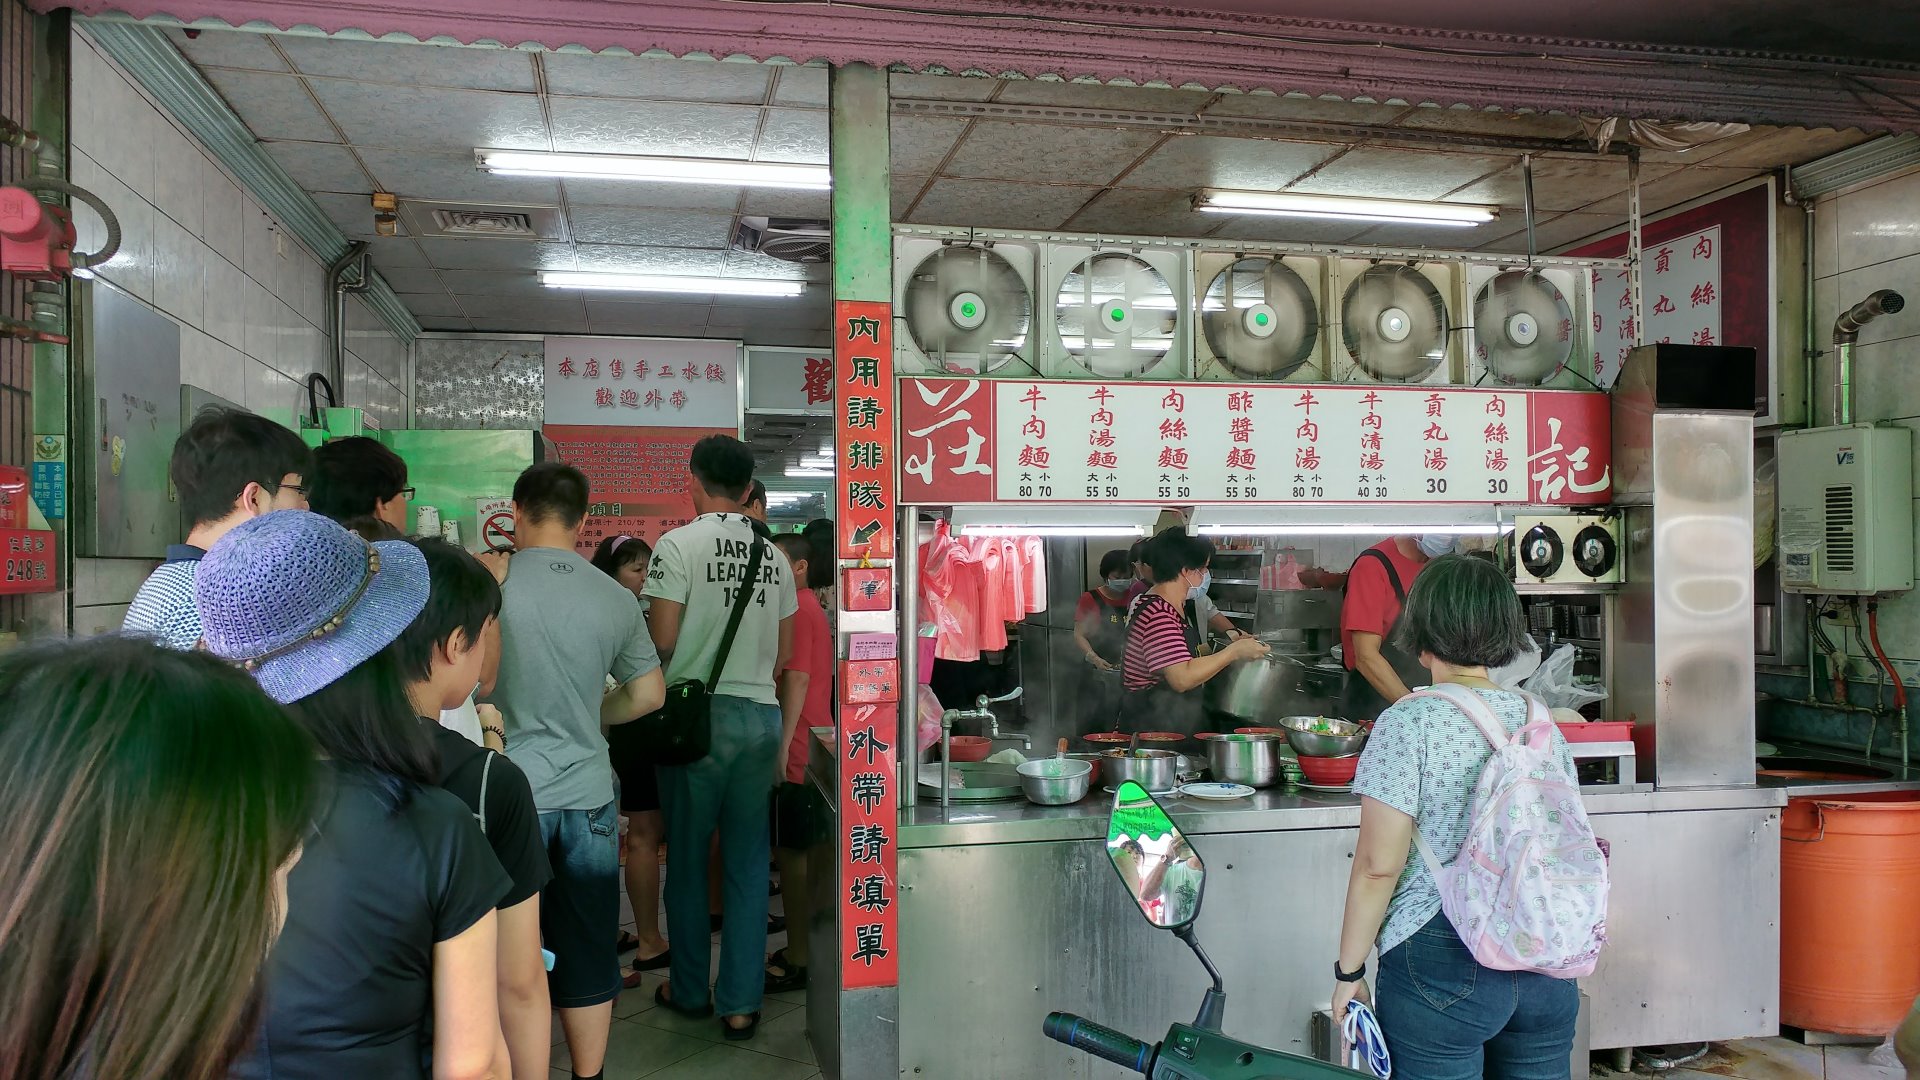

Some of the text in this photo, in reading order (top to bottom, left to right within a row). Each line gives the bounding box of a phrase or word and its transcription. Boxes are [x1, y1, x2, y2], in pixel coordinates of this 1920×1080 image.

[557, 356, 726, 383] 本店售手工水餃
[594, 387, 687, 410] 歡迎外帶
[846, 315, 886, 511] 內用請排隊
[1018, 385, 1050, 469] 牛肉麵
[1086, 386, 1118, 469] 牛肉湯麵
[1158, 388, 1189, 470] 肉絲麵
[1294, 390, 1321, 471] 牛肉湯
[1358, 390, 1385, 471] 牛肉清湯
[1422, 393, 1449, 471] 貢丸湯
[1484, 395, 1509, 472] 肉絲湯
[1527, 417, 1610, 503] 記
[1019, 486, 1052, 498] 80 70
[1086, 486, 1118, 498] 55 50
[1158, 486, 1190, 498] 55 50
[1226, 486, 1257, 498] 55 50
[1292, 486, 1324, 498] 80 70
[1357, 486, 1388, 498] 40 30
[1426, 478, 1447, 494] 30
[1488, 479, 1508, 494] 30
[590, 501, 622, 517] 項目
[715, 538, 773, 560] JARO
[848, 725, 891, 967] 外帶請填單
